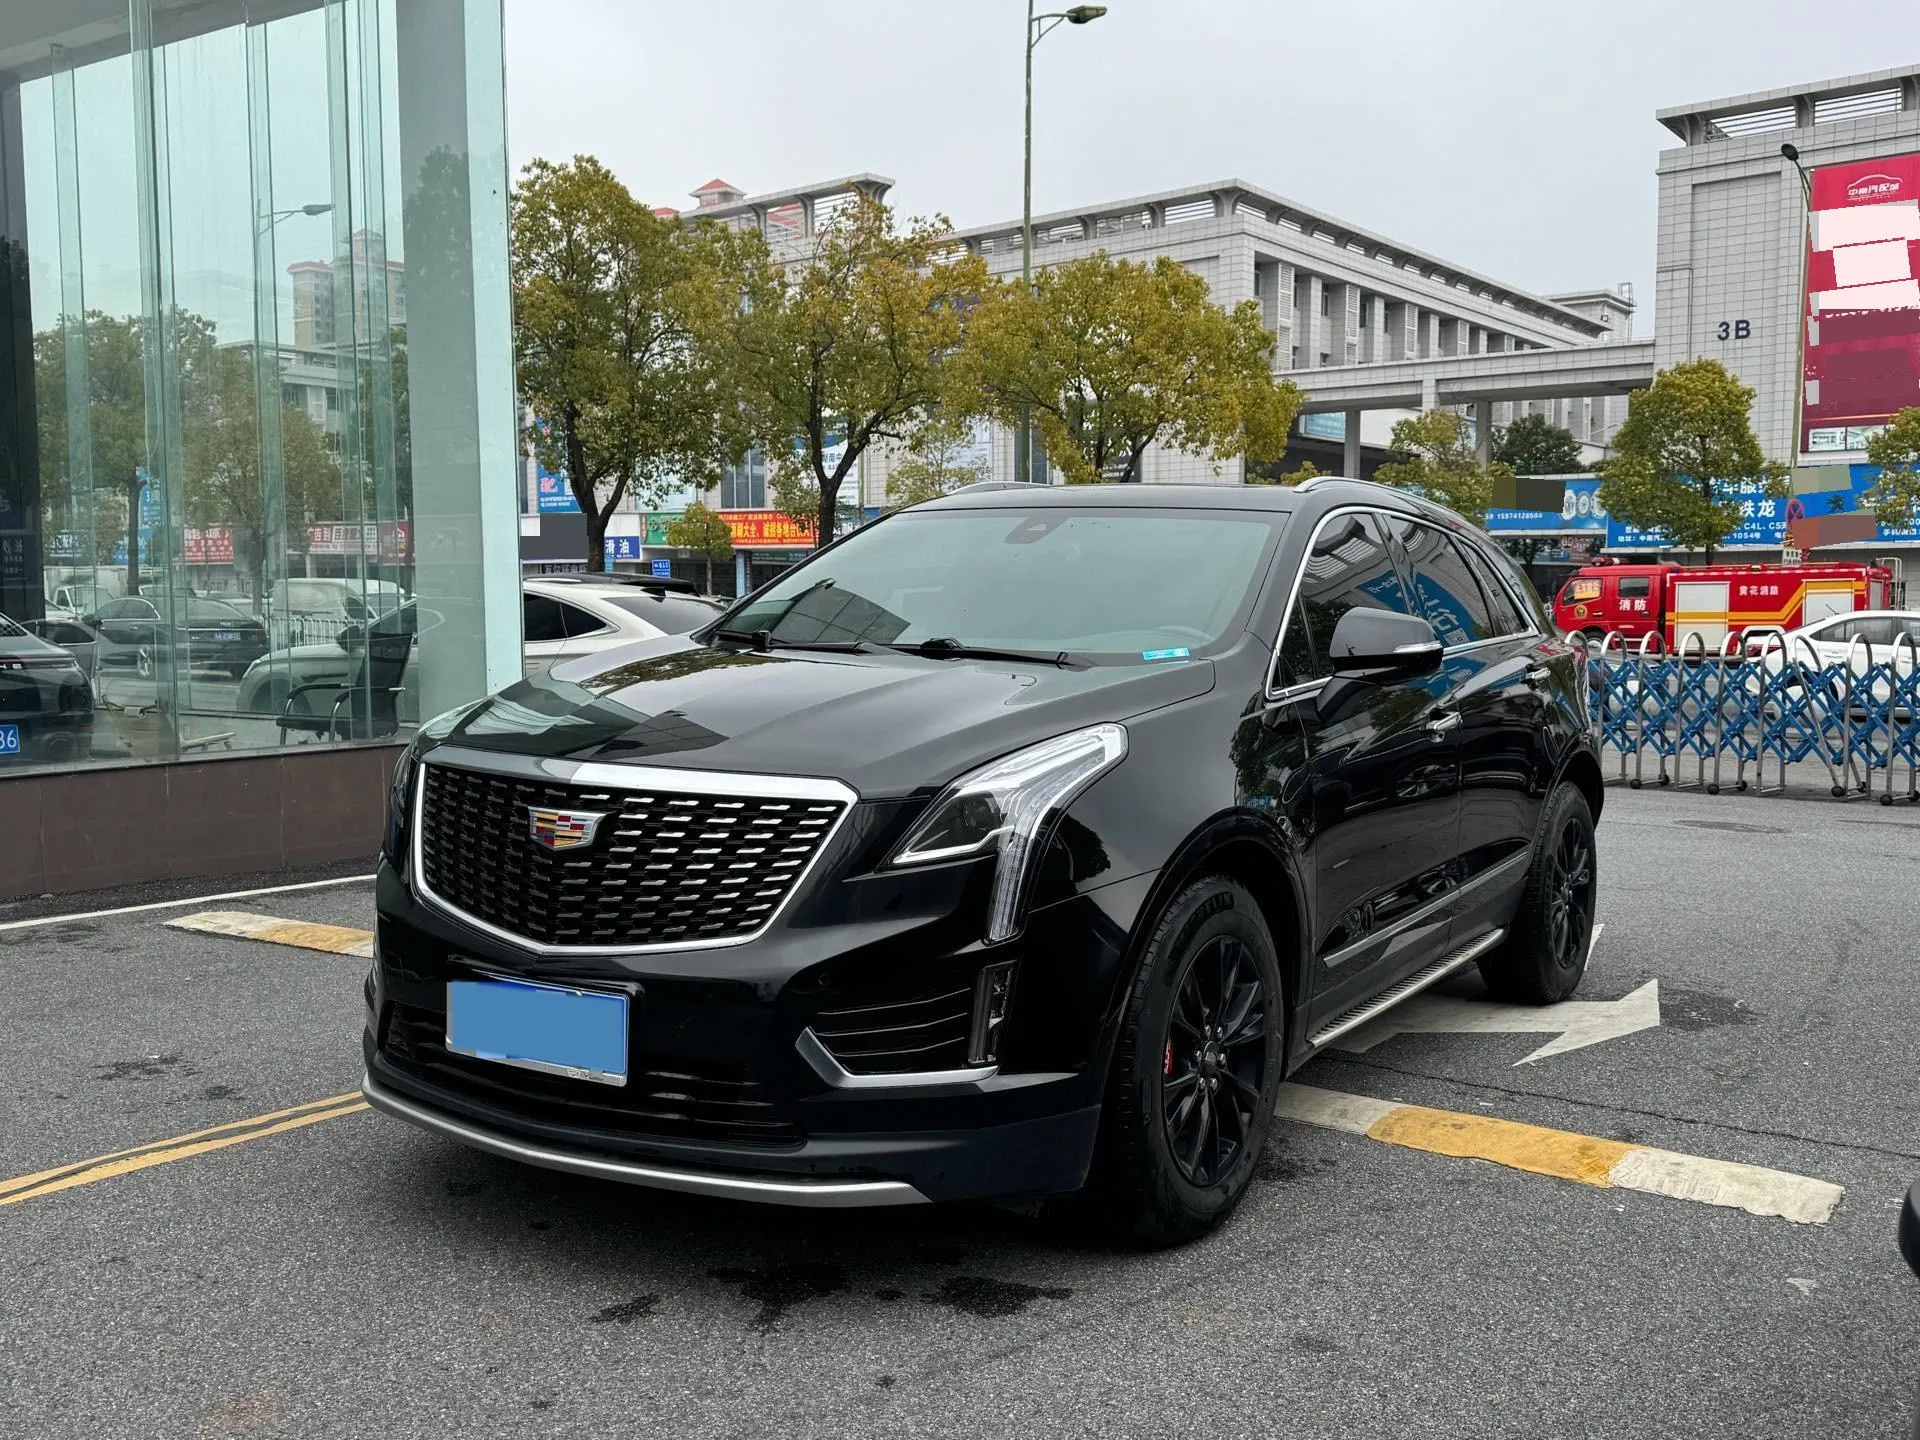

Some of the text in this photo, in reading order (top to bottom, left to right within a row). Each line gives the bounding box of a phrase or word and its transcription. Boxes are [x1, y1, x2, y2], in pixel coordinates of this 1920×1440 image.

[1716, 319, 1751, 341] 3B
[1738, 584, 1780, 596] 黄花消防
[1618, 599, 1647, 611] 消防
